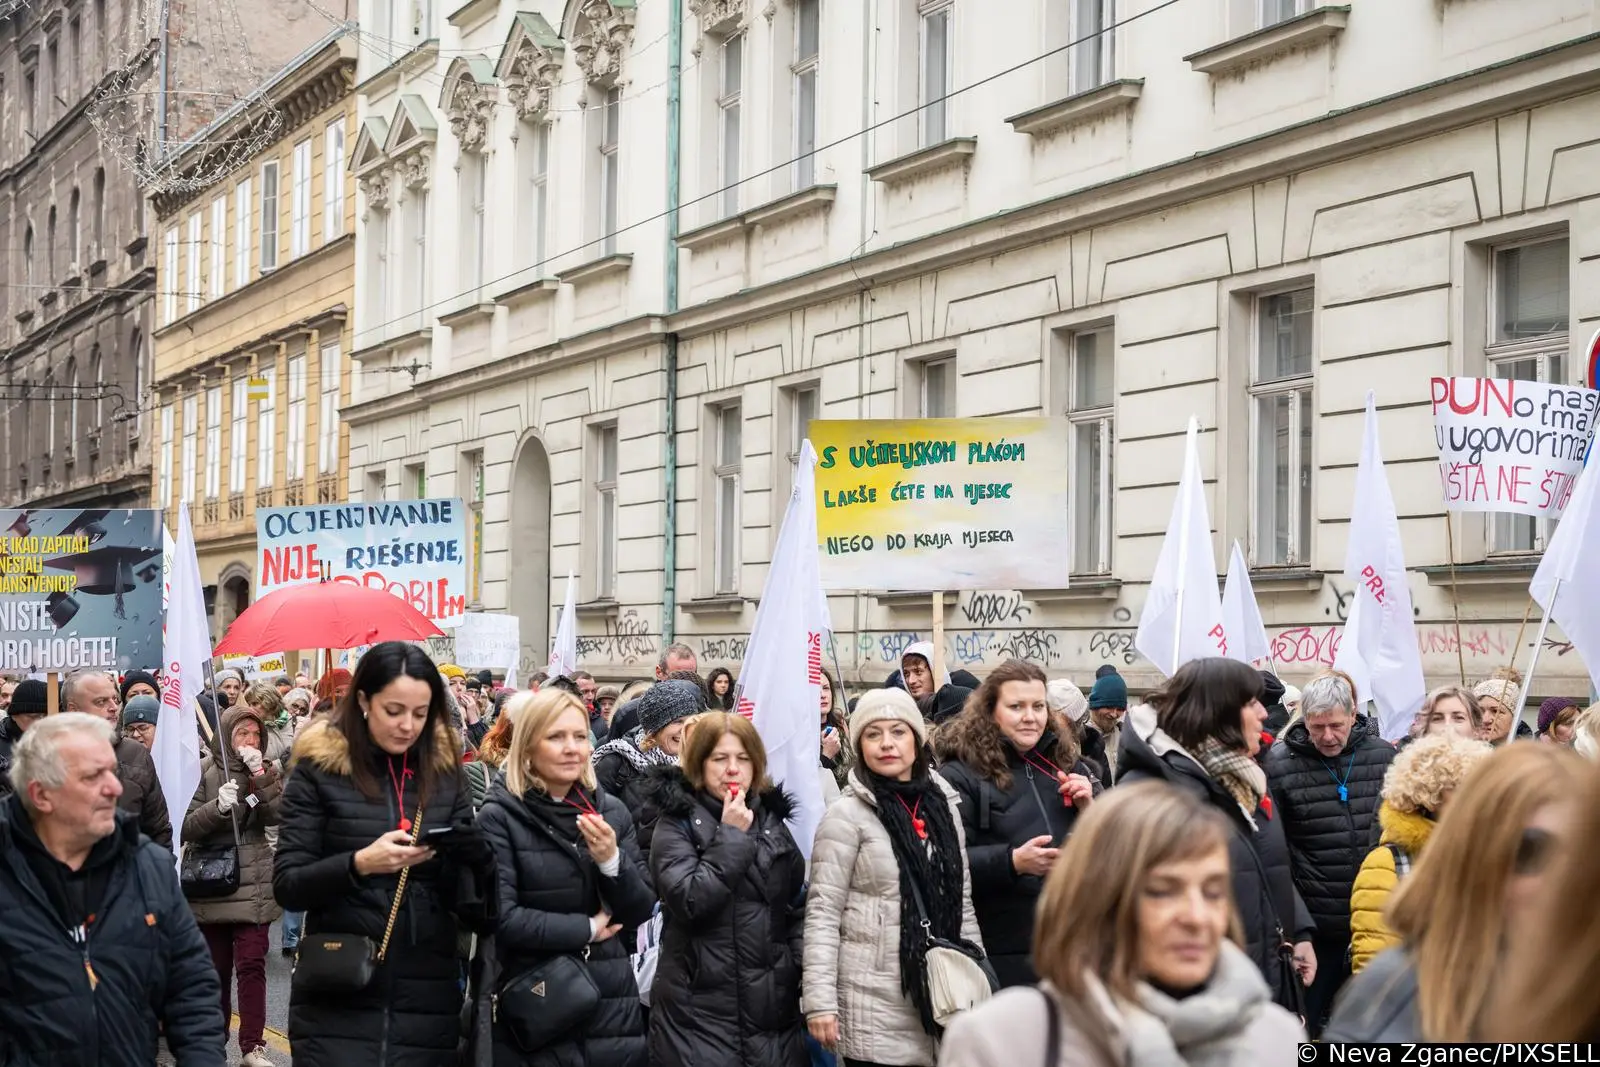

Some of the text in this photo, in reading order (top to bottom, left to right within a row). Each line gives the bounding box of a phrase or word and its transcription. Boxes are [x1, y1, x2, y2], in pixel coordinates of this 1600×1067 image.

[1548, 389, 1597, 411] nas
[820, 438, 1025, 469] S UČITELJSKOM PLAĆOM
[824, 481, 1013, 508] LAKŠE ĆETE NA MJESEC
[1497, 465, 1532, 505] NE
[265, 501, 452, 538] OCJENJIVANJE
[12, 536, 39, 554] IKAD
[41, 536, 89, 554] ZAPITALI
[827, 530, 1014, 555] NEGO DO KRAJA MJESECA
[261, 544, 321, 586] NIJE
[346, 537, 464, 571] RJEŠENJE,
[334, 572, 464, 620] OBLEM
[38, 631, 118, 668] HOĆETE!
